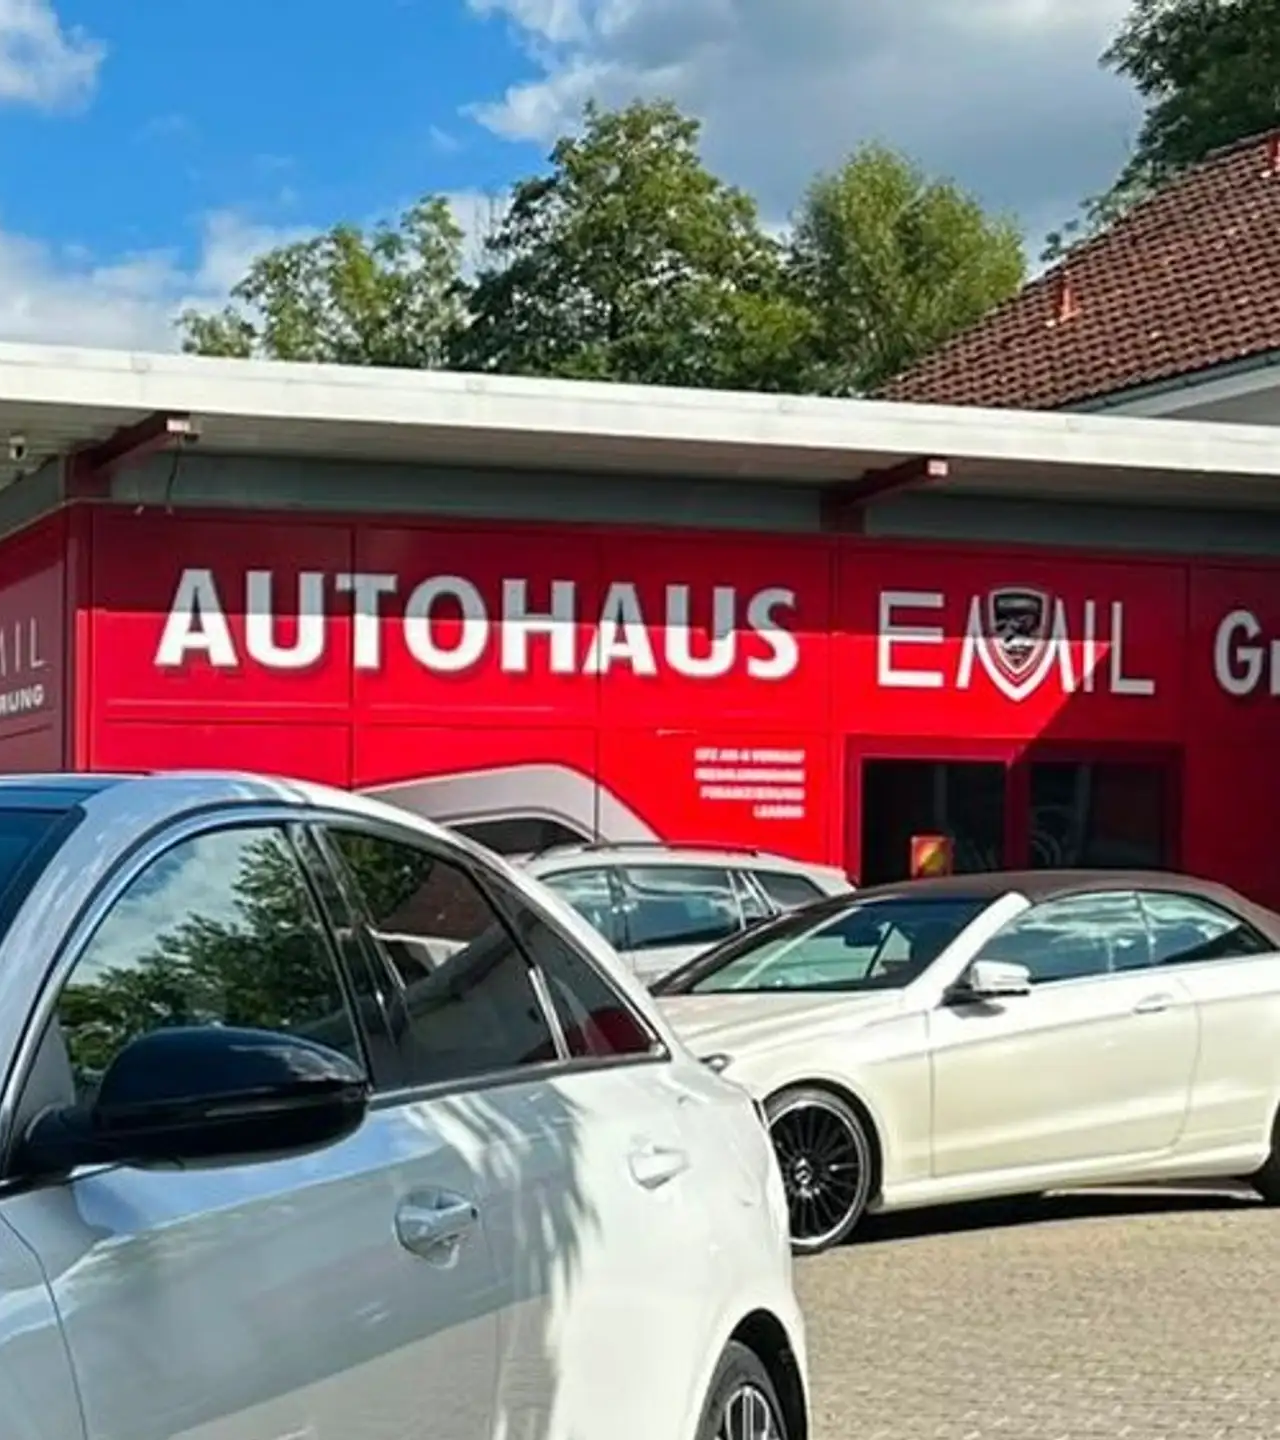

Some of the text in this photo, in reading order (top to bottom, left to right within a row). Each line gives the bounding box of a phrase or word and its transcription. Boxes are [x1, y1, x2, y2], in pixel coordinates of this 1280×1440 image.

[154, 568, 1280, 702] AUTOHAUS EMIL G
